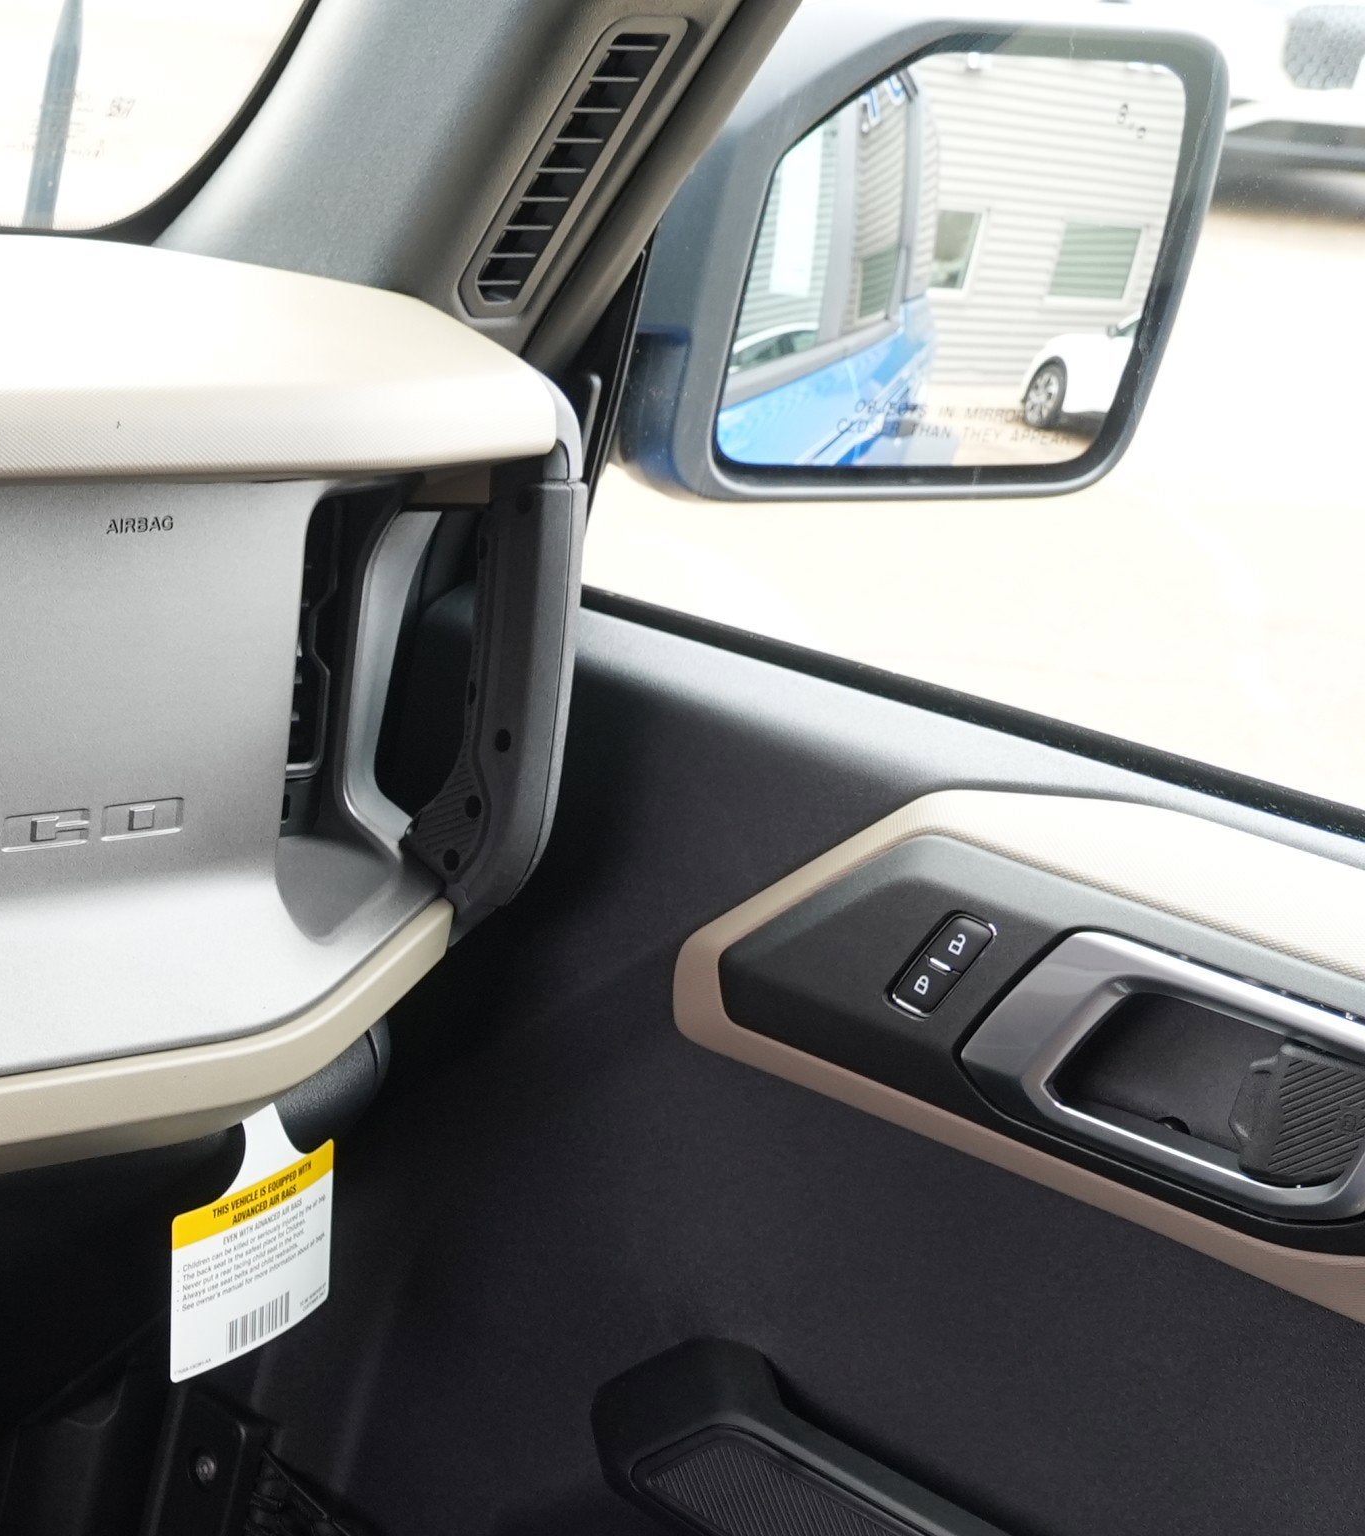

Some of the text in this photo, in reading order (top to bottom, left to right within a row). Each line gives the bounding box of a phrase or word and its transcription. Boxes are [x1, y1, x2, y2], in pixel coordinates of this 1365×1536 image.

[105, 515, 174, 534] AIRBAG
[213, 1161, 312, 1219] THIS VEHICLE IS EQUIPPED WITH
[232, 1184, 297, 1225] ADVANCED AIR BAGS
[182, 1257, 211, 1272] Children
